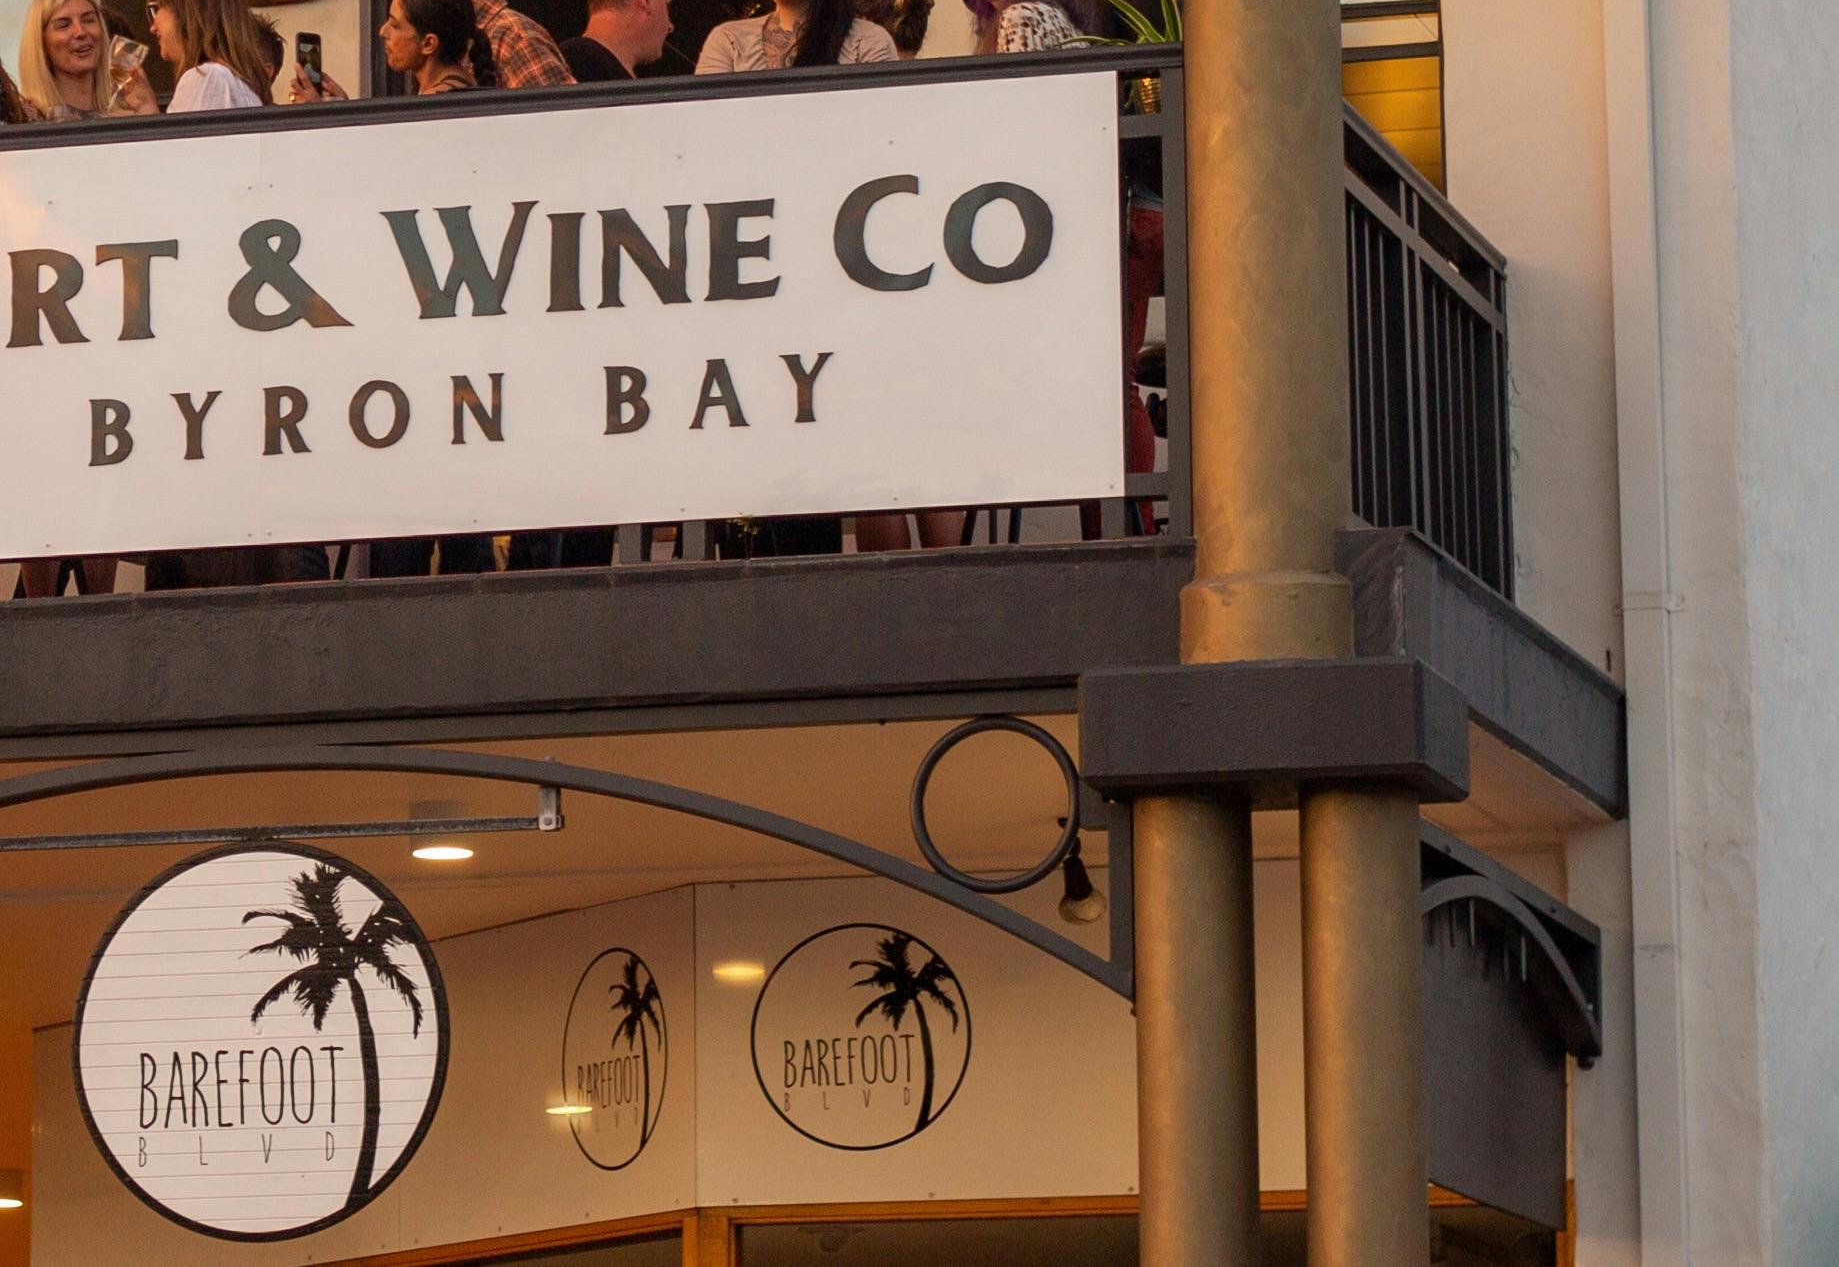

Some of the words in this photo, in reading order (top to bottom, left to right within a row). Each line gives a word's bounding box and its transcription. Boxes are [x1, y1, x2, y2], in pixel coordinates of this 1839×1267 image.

[228, 219, 354, 332] &
[88, 372, 505, 467] BYRON
[603, 352, 835, 436] BAY
[139, 1045, 345, 1129] BAREFOOT
[576, 1054, 641, 1109] BAREFOOT
[783, 1034, 915, 1088] BAREFOOT
[783, 1087, 910, 1112] BLVD
[139, 1130, 335, 1168] BLVD
